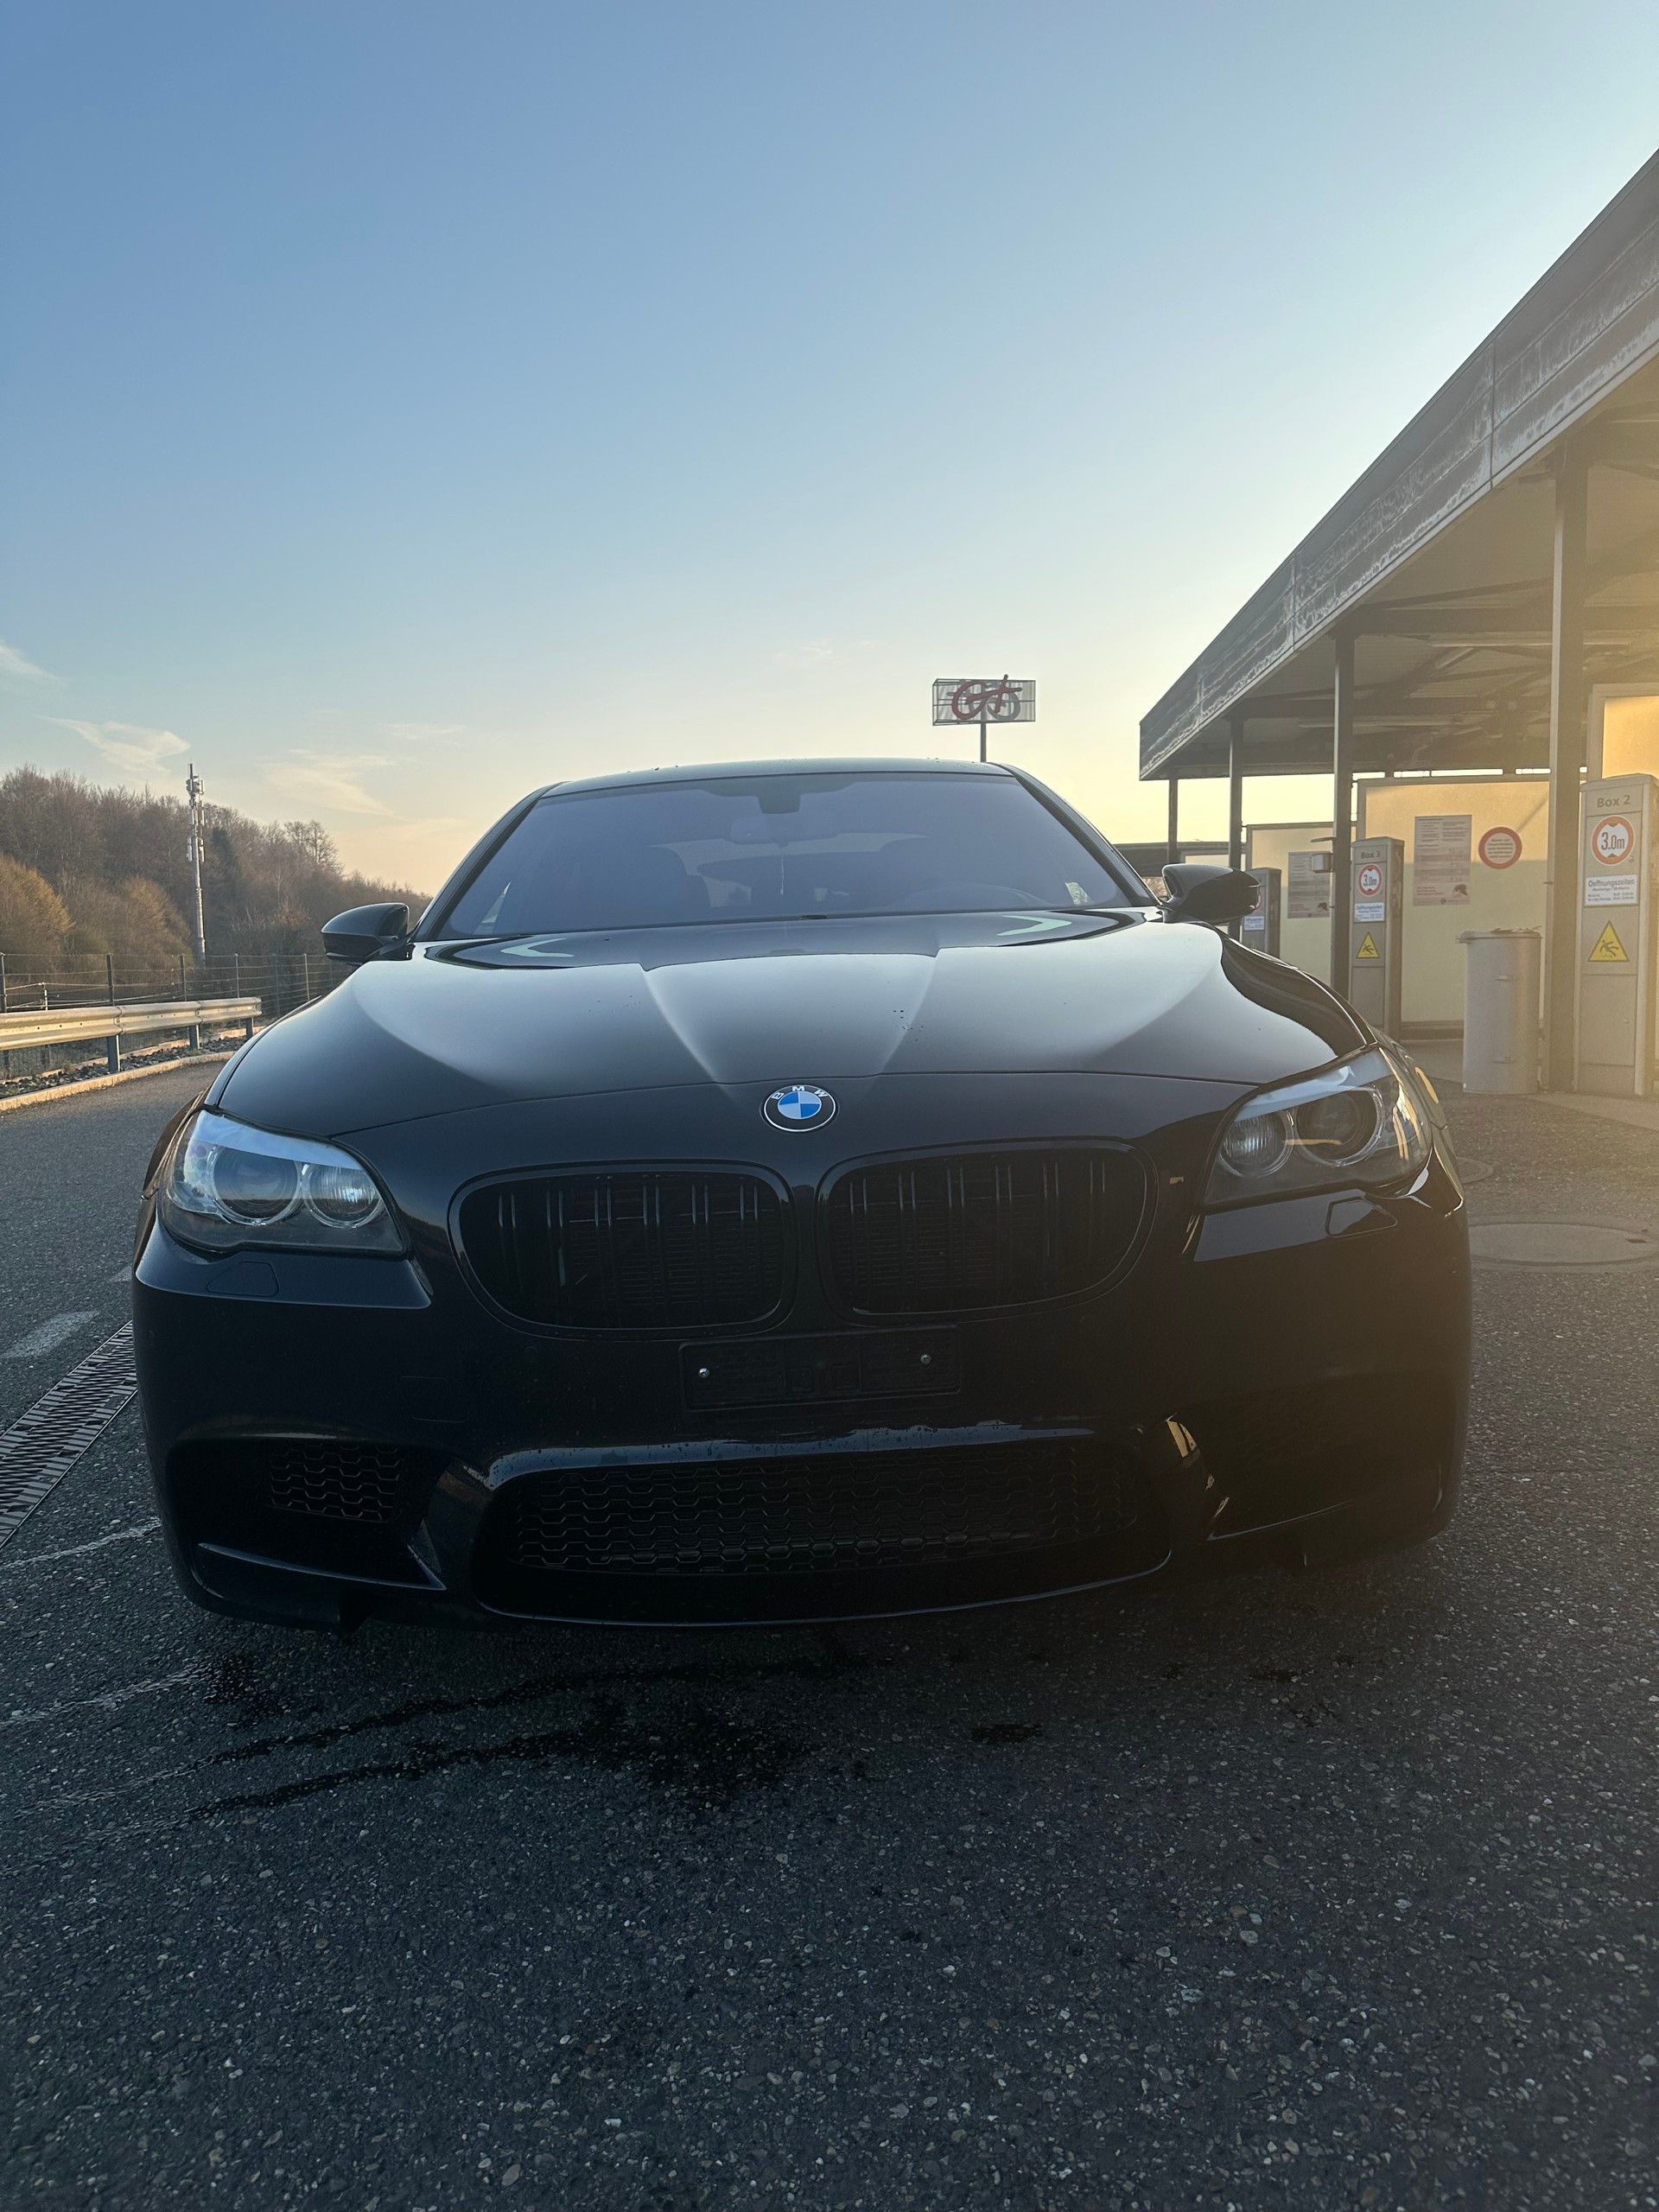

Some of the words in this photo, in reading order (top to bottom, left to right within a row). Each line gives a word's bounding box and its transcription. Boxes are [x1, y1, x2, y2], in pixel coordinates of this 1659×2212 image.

[1597, 797, 1619, 808] Box
[1624, 794, 1631, 805] 2
[1601, 832, 1624, 850] 3.0m
[771, 1085, 829, 1100] BMW
